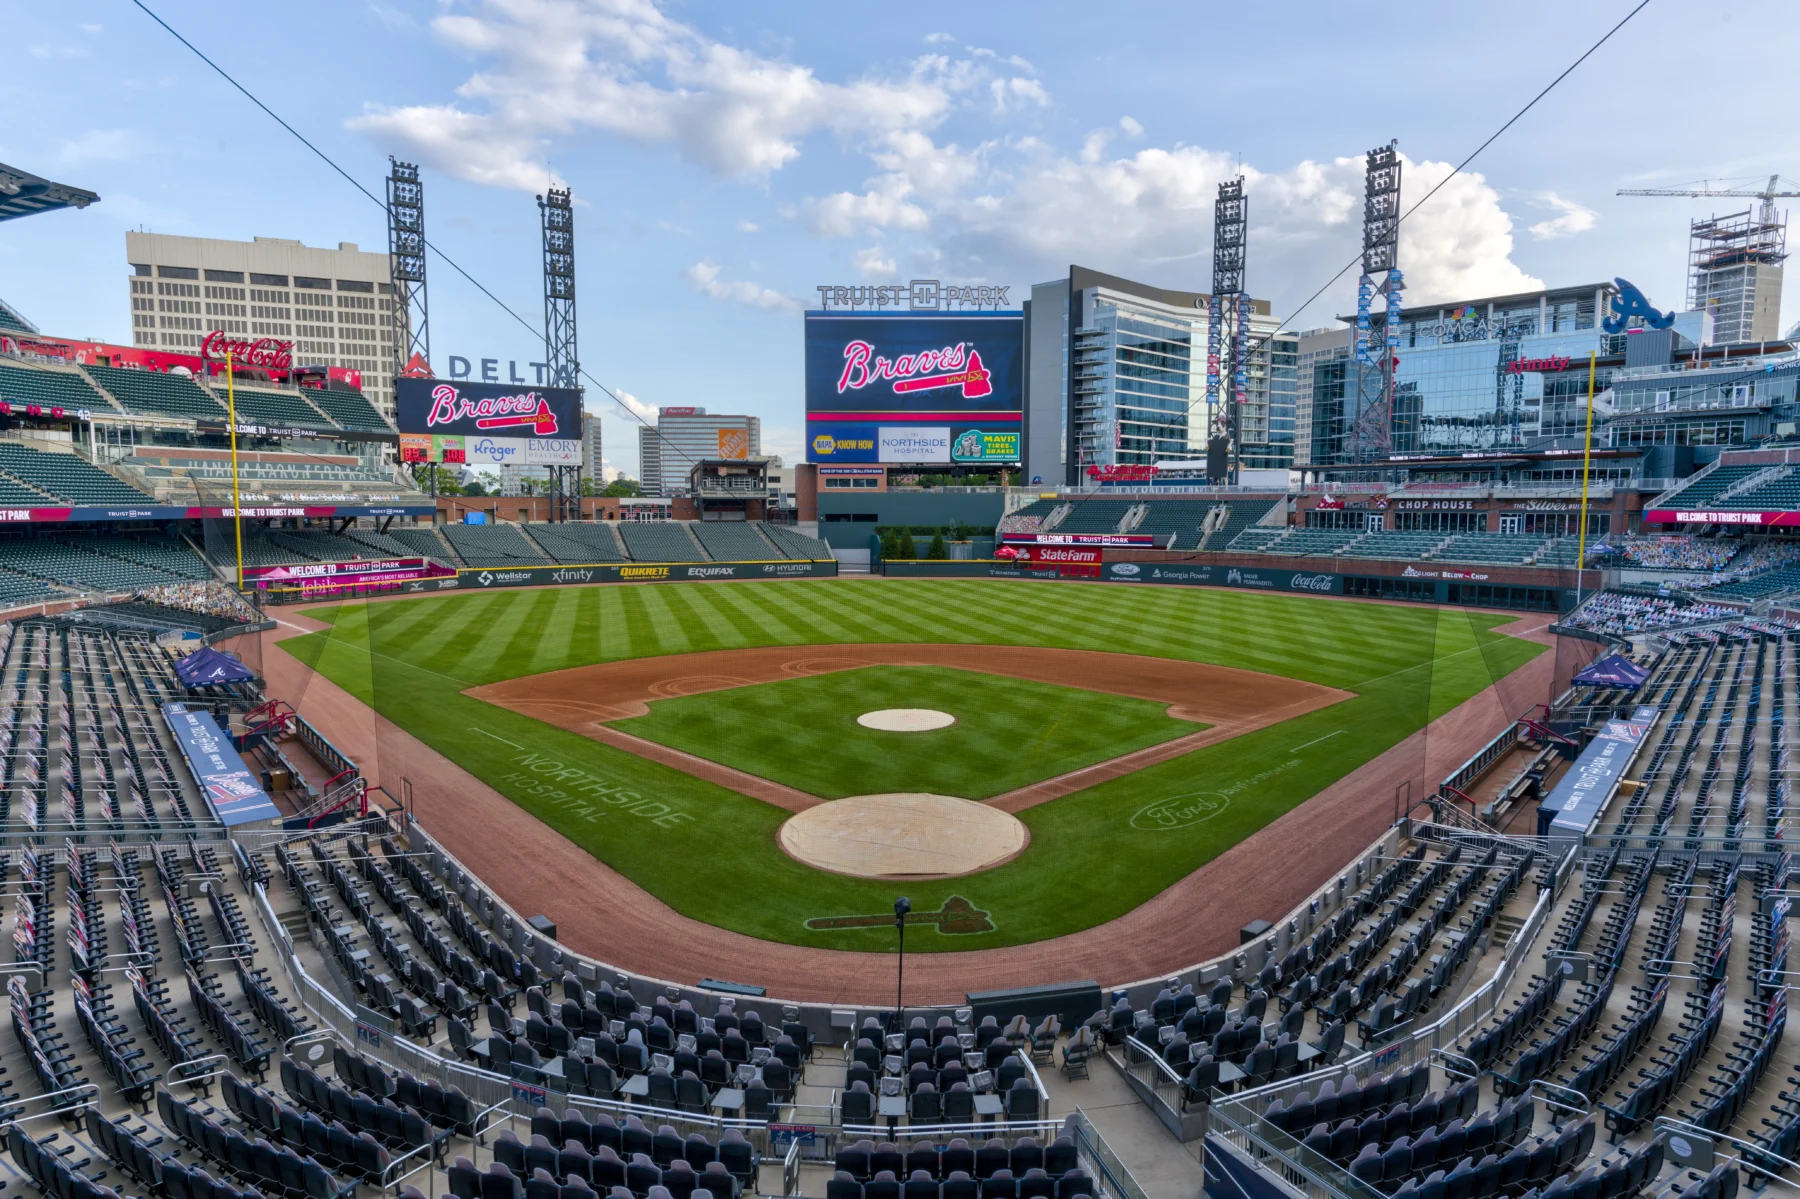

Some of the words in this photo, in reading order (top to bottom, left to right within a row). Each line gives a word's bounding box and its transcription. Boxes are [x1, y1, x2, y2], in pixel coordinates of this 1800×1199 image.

[817, 285, 904, 305] TRUIST
[946, 285, 1010, 305] PARK
[1420, 316, 1508, 338] COMCAST
[201, 330, 296, 368] Coca-Cola
[837, 340, 966, 394] Braves
[1508, 354, 1570, 375] xfinity
[449, 355, 575, 388] DELTA
[26, 404, 42, 416] 44
[427, 384, 536, 427] Braves
[76, 408, 91, 420] 42
[226, 424, 257, 434] WELCOME
[258, 426, 266, 434] TO
[269, 427, 291, 435] TRUIST
[528, 440, 579, 452] EMORY
[720, 430, 745, 458] HOME
[816, 440, 832, 449] NAPA
[837, 440, 857, 449] KNOW
[858, 440, 873, 449] HOW
[882, 438, 947, 447] NORTHSIDE
[474, 439, 516, 461] Kroger
[188, 461, 248, 478] HANK
[245, 462, 310, 480] AARON
[1316, 498, 1344, 509] Coors
[1398, 501, 1429, 509] CHOP
[1433, 500, 1473, 509] HOUSE
[1525, 499, 1567, 511] Silver
[8, 510, 30, 521] PARK
[222, 508, 256, 517] WELCOME
[256, 508, 265, 516] TO
[266, 508, 287, 516] TRUIST
[288, 507, 305, 516] PARK
[1676, 512, 1708, 522] WELCOME
[1709, 513, 1717, 522] TO
[1717, 513, 1741, 522] TRUIST
[1742, 513, 1762, 523] PARK
[1036, 535, 1064, 543] WELCOME
[1065, 535, 1073, 543] TO
[289, 565, 324, 576] WELCOME
[325, 564, 336, 574] TO
[344, 563, 370, 572] TRUIST
[381, 561, 400, 569] PARK
[620, 567, 669, 577] QUIKRETE
[688, 567, 735, 578] EQUIFAX
[1116, 564, 1133, 573] Ford
[359, 574, 384, 582] AMERICA'S
[496, 572, 532, 580] Wellstar
[552, 568, 593, 583] xfinity
[1163, 571, 1188, 580] Georgia
[1291, 573, 1333, 591] Coca-Cola
[510, 753, 696, 829] NORTHSIDE
[500, 772, 607, 823] HOSPITAL
[1147, 798, 1219, 825] Ford
